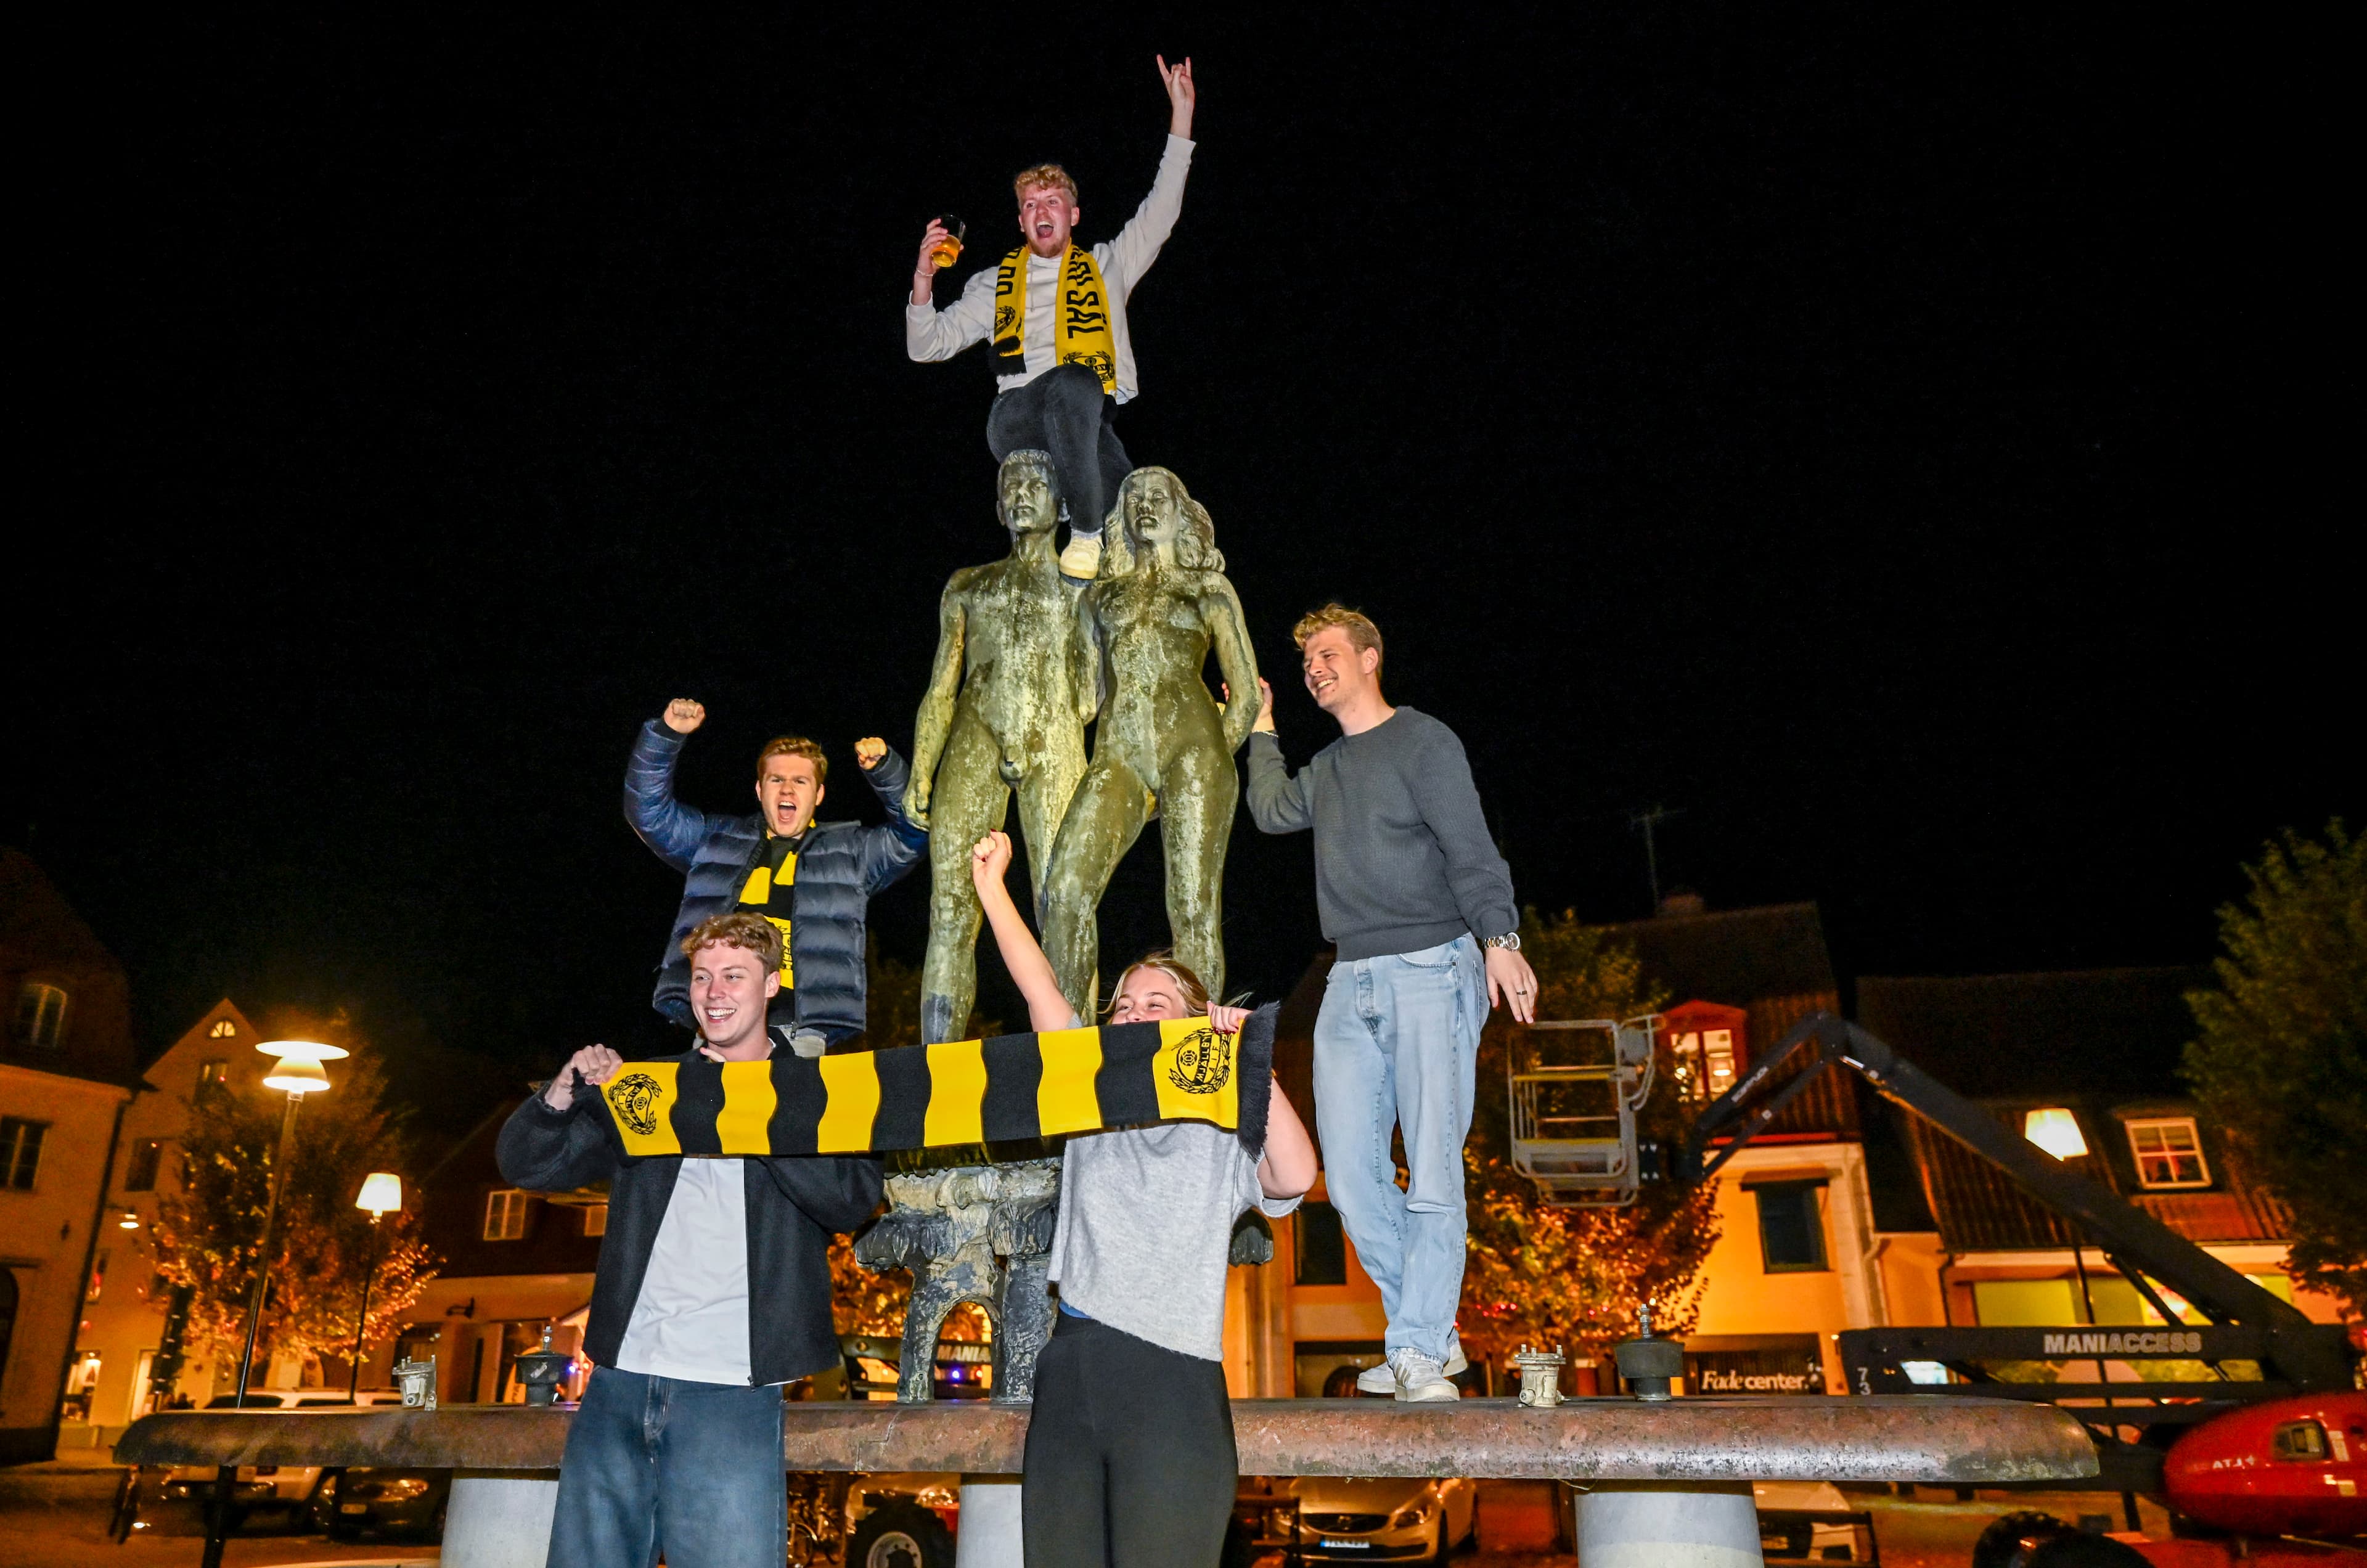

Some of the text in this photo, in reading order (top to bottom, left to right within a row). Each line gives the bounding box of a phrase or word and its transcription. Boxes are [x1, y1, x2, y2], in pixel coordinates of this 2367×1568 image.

[1196, 1036, 1211, 1082] MJÄLLBY
[1209, 1046, 1219, 1073] AIF
[2043, 1332, 2202, 1354] MANIACCESS
